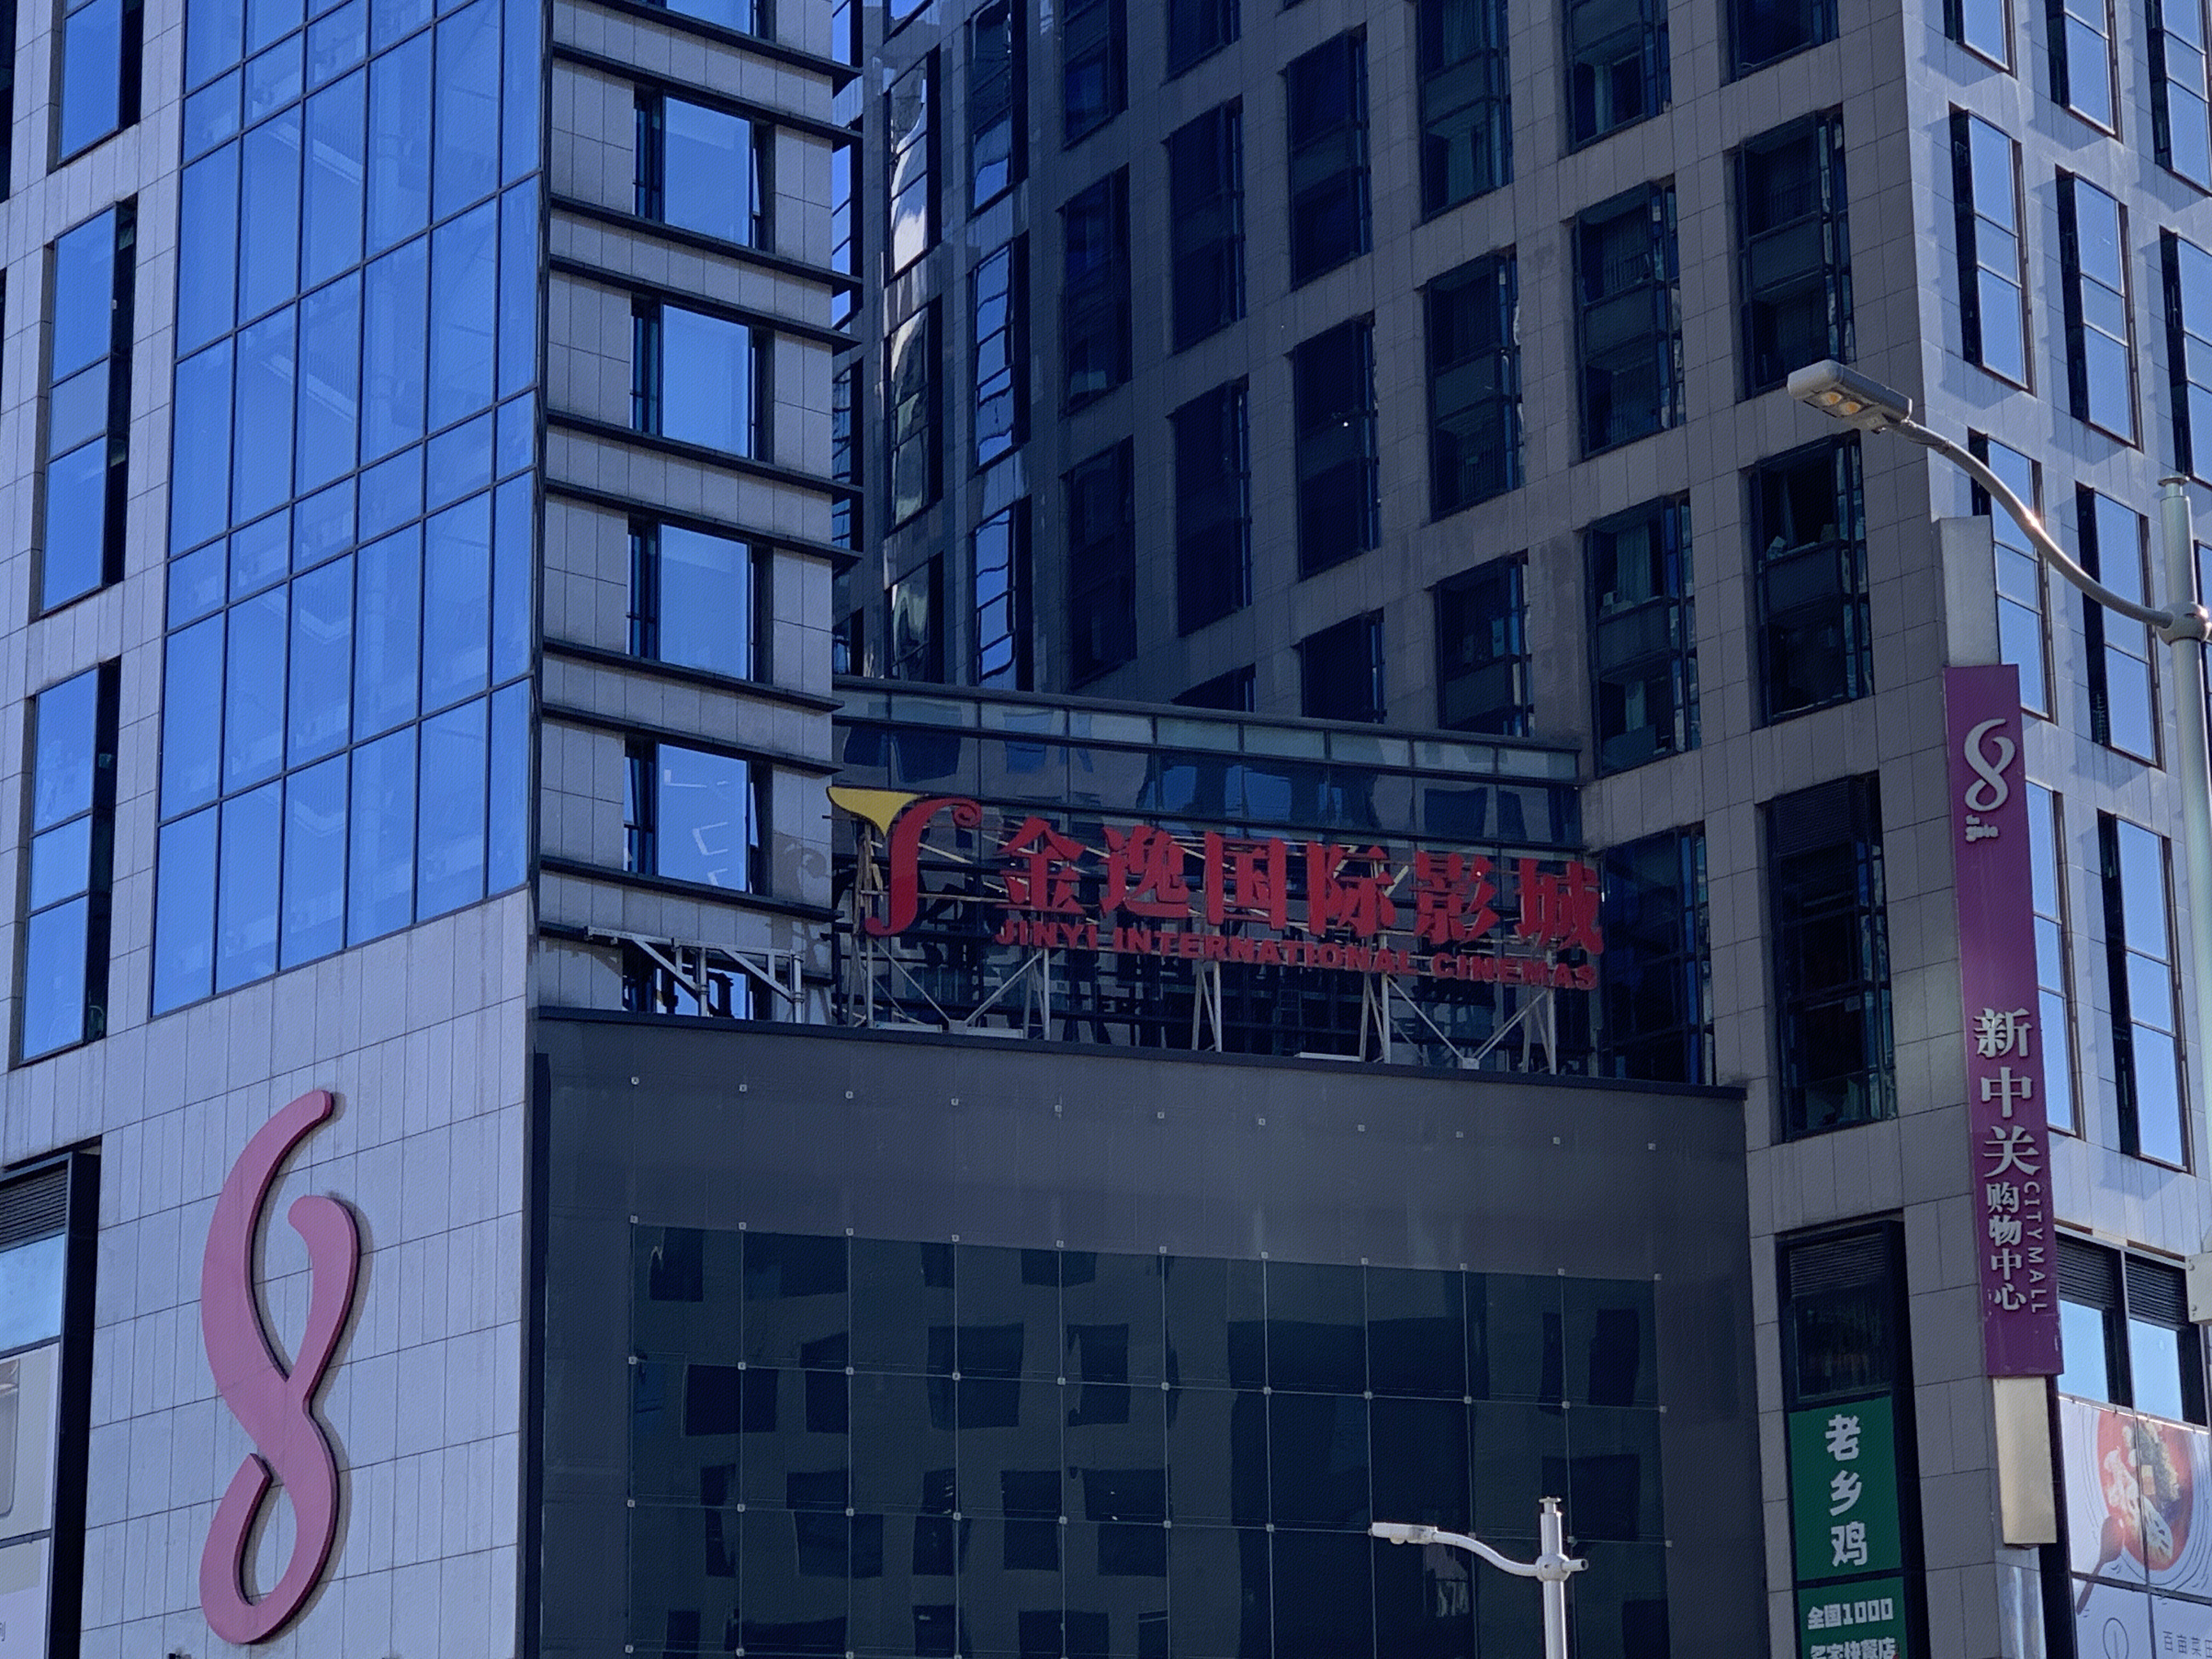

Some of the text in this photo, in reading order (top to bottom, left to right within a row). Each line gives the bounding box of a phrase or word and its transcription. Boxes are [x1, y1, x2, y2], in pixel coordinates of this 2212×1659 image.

[995, 815, 1604, 955] 金逸国际影城
[995, 919, 1598, 990] JINYI INTERNATIONAL CINEMAS
[1825, 1414, 1868, 1567] 老乡鸡
[1808, 1598, 1894, 1630] 全国1000
